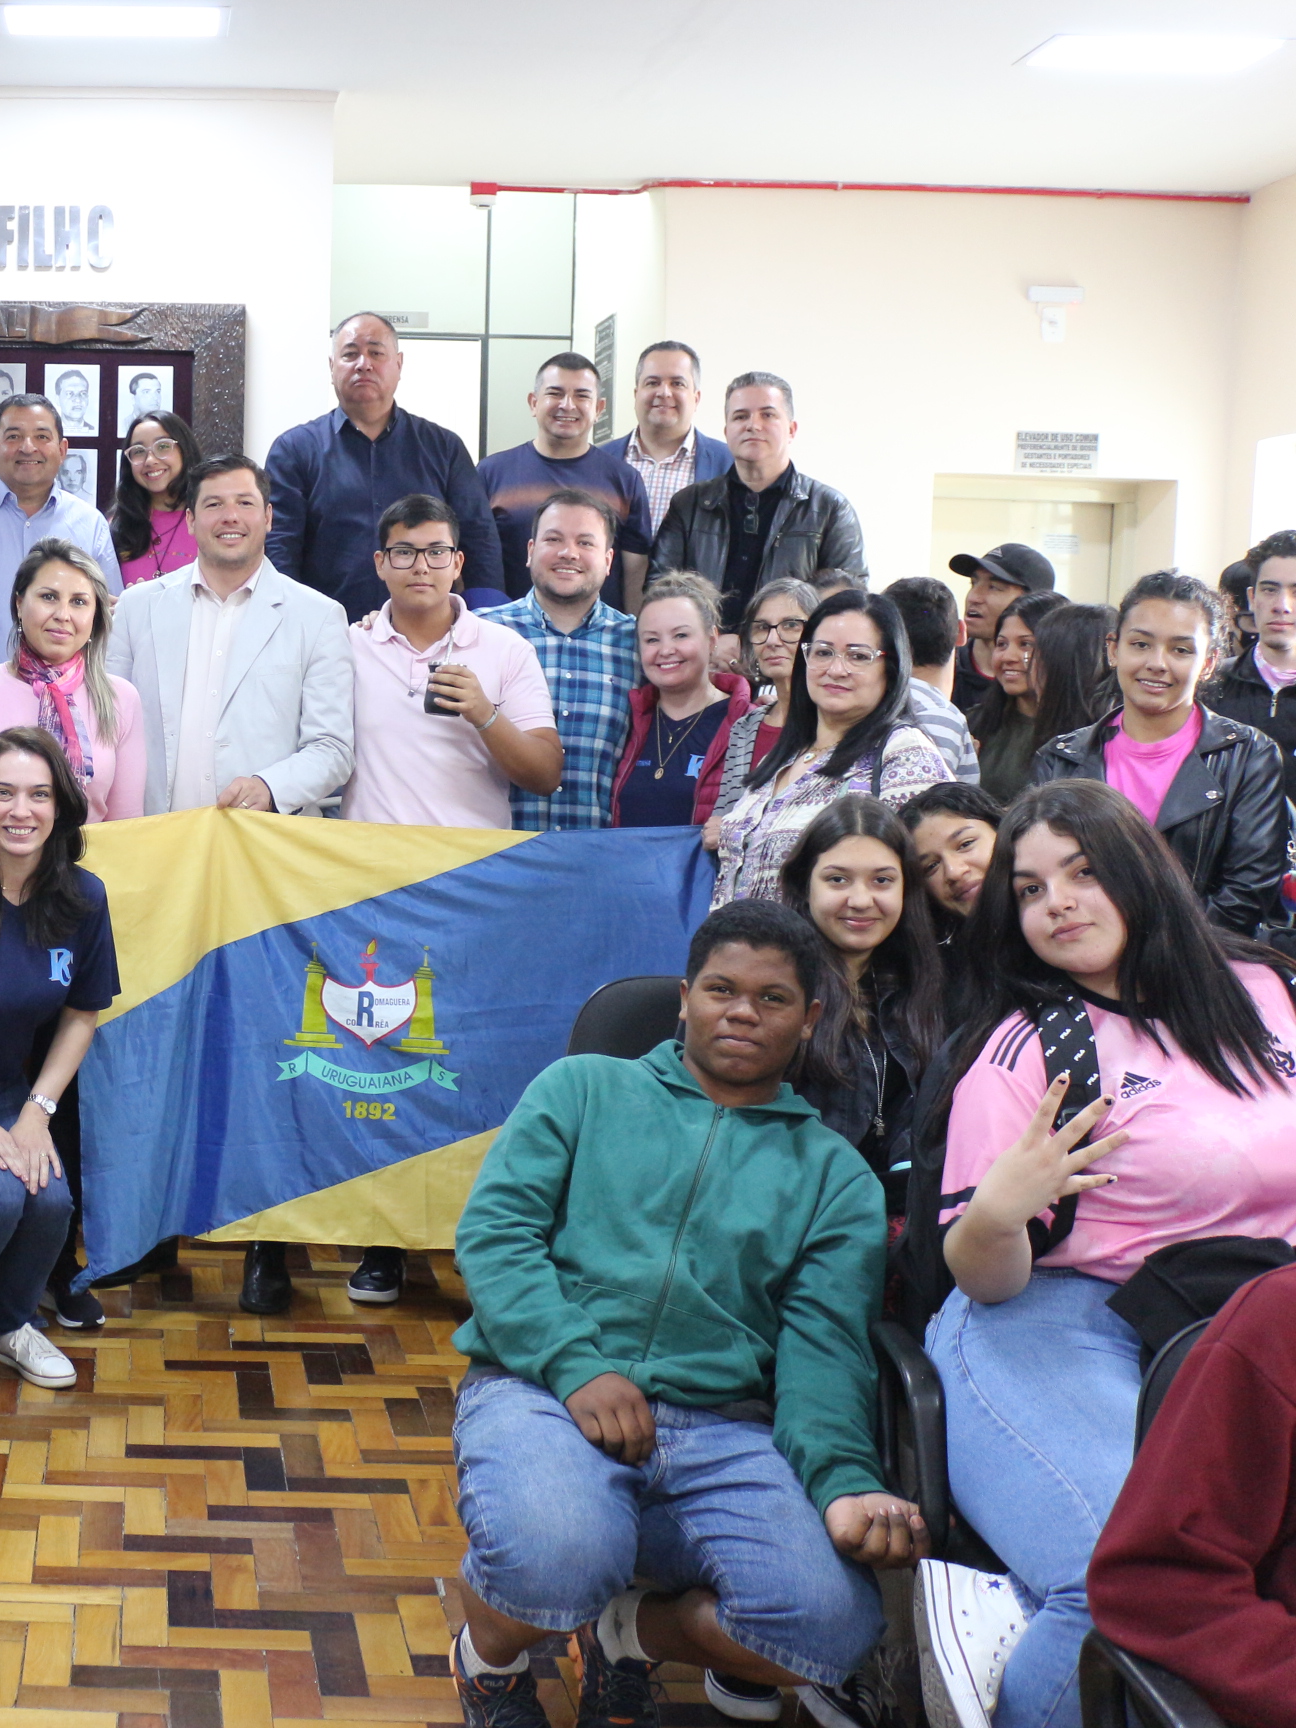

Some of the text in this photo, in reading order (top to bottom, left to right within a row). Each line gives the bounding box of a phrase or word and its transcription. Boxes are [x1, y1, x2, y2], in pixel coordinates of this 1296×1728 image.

[1017, 432, 1098, 442] ELEVADOR DE USO COMUM
[288, 1063, 446, 1090] R URUGUAIANA S
[1120, 1079, 1162, 1099] adidas
[342, 1100, 396, 1120] 1892
